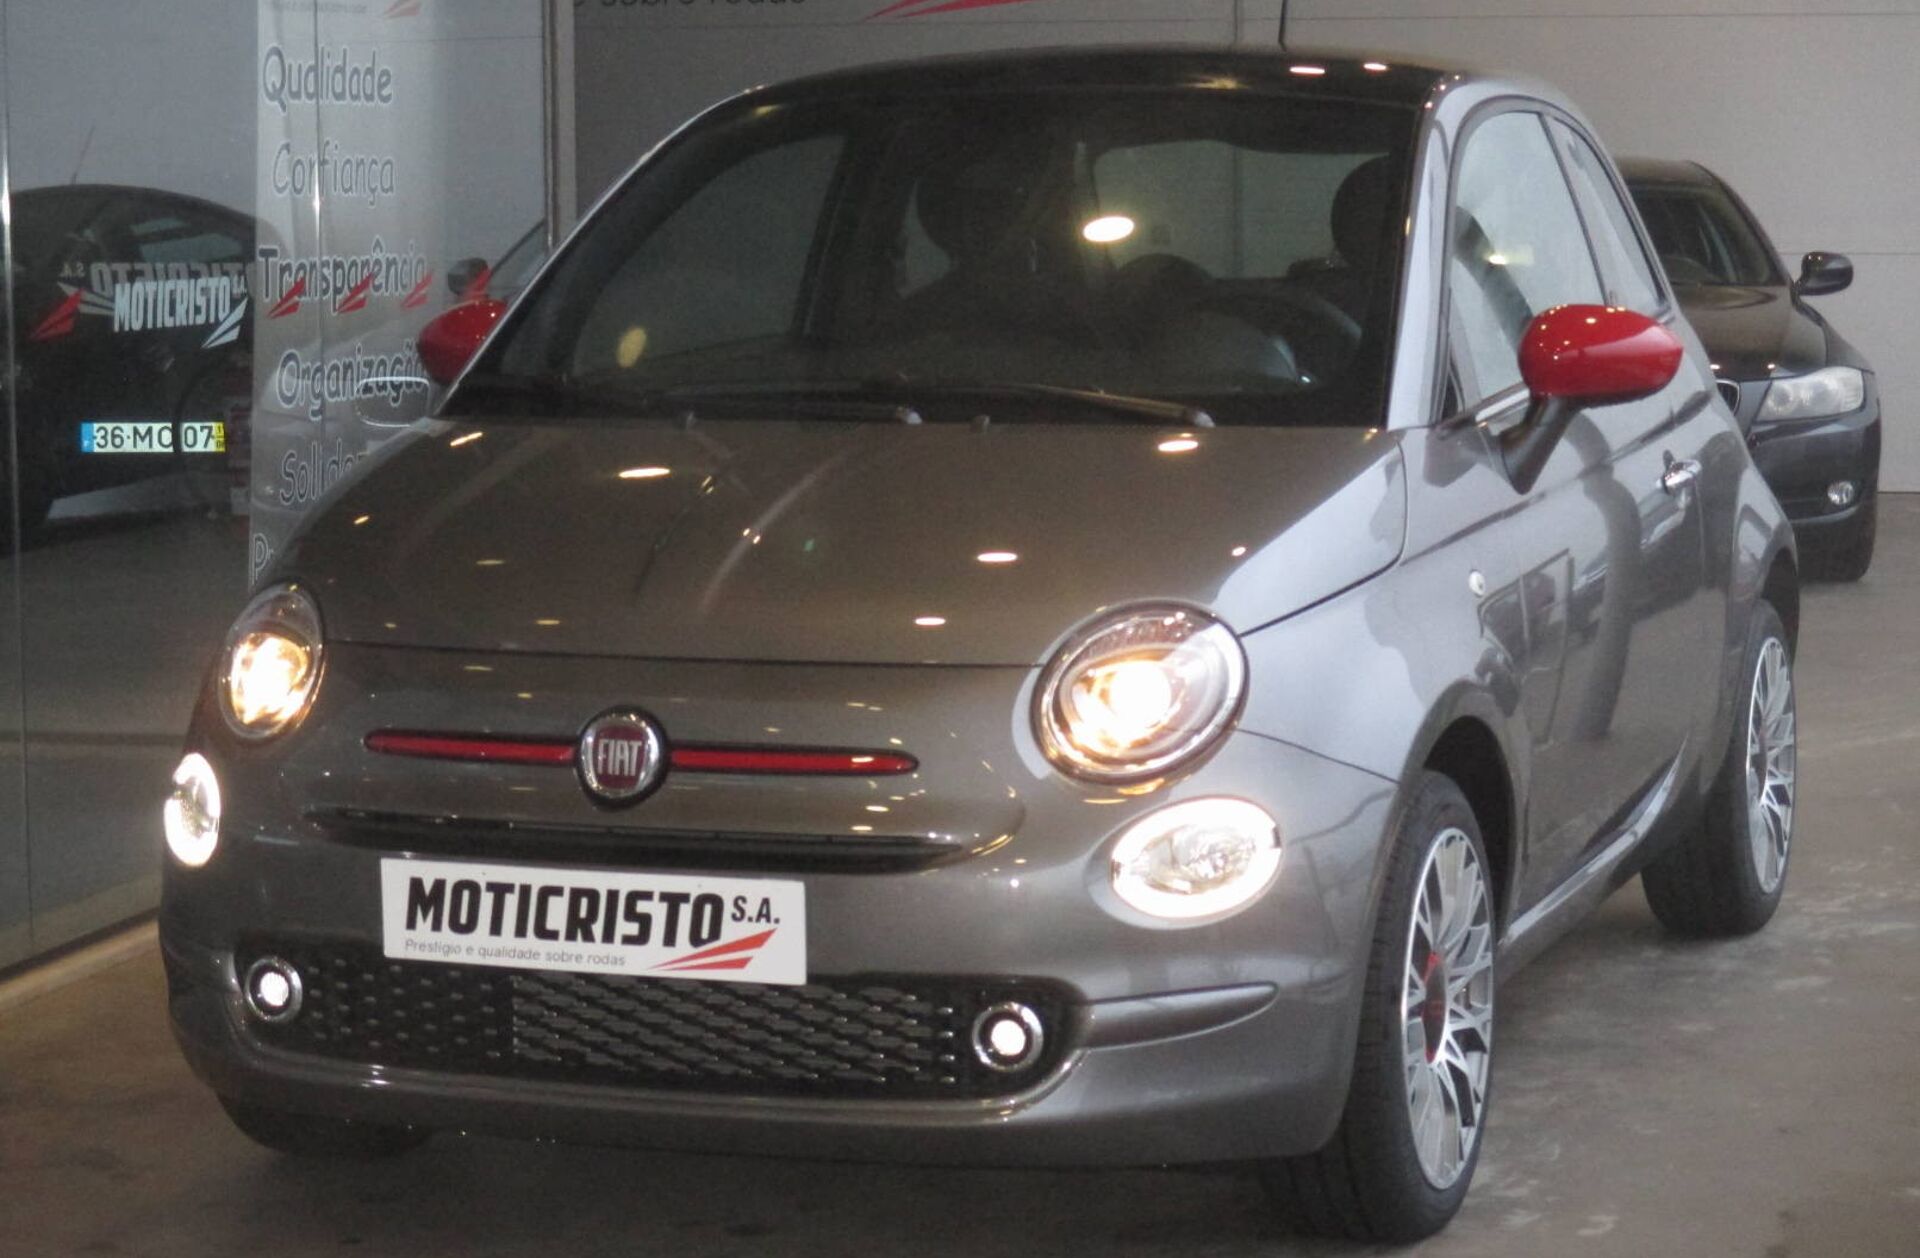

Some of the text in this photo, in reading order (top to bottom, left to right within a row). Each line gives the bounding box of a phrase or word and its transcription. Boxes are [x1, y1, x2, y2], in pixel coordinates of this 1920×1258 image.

[263, 46, 393, 113] Qualidade
[113, 276, 231, 332] MOTICRISTO
[258, 236, 427, 314] Transparência
[598, 738, 642, 777] FIAT
[405, 876, 781, 948] MOTICRISTO S.A.
[465, 945, 475, 955] e
[478, 945, 541, 962] qualidade
[545, 950, 583, 964] sobre
[587, 953, 626, 966] rodas
